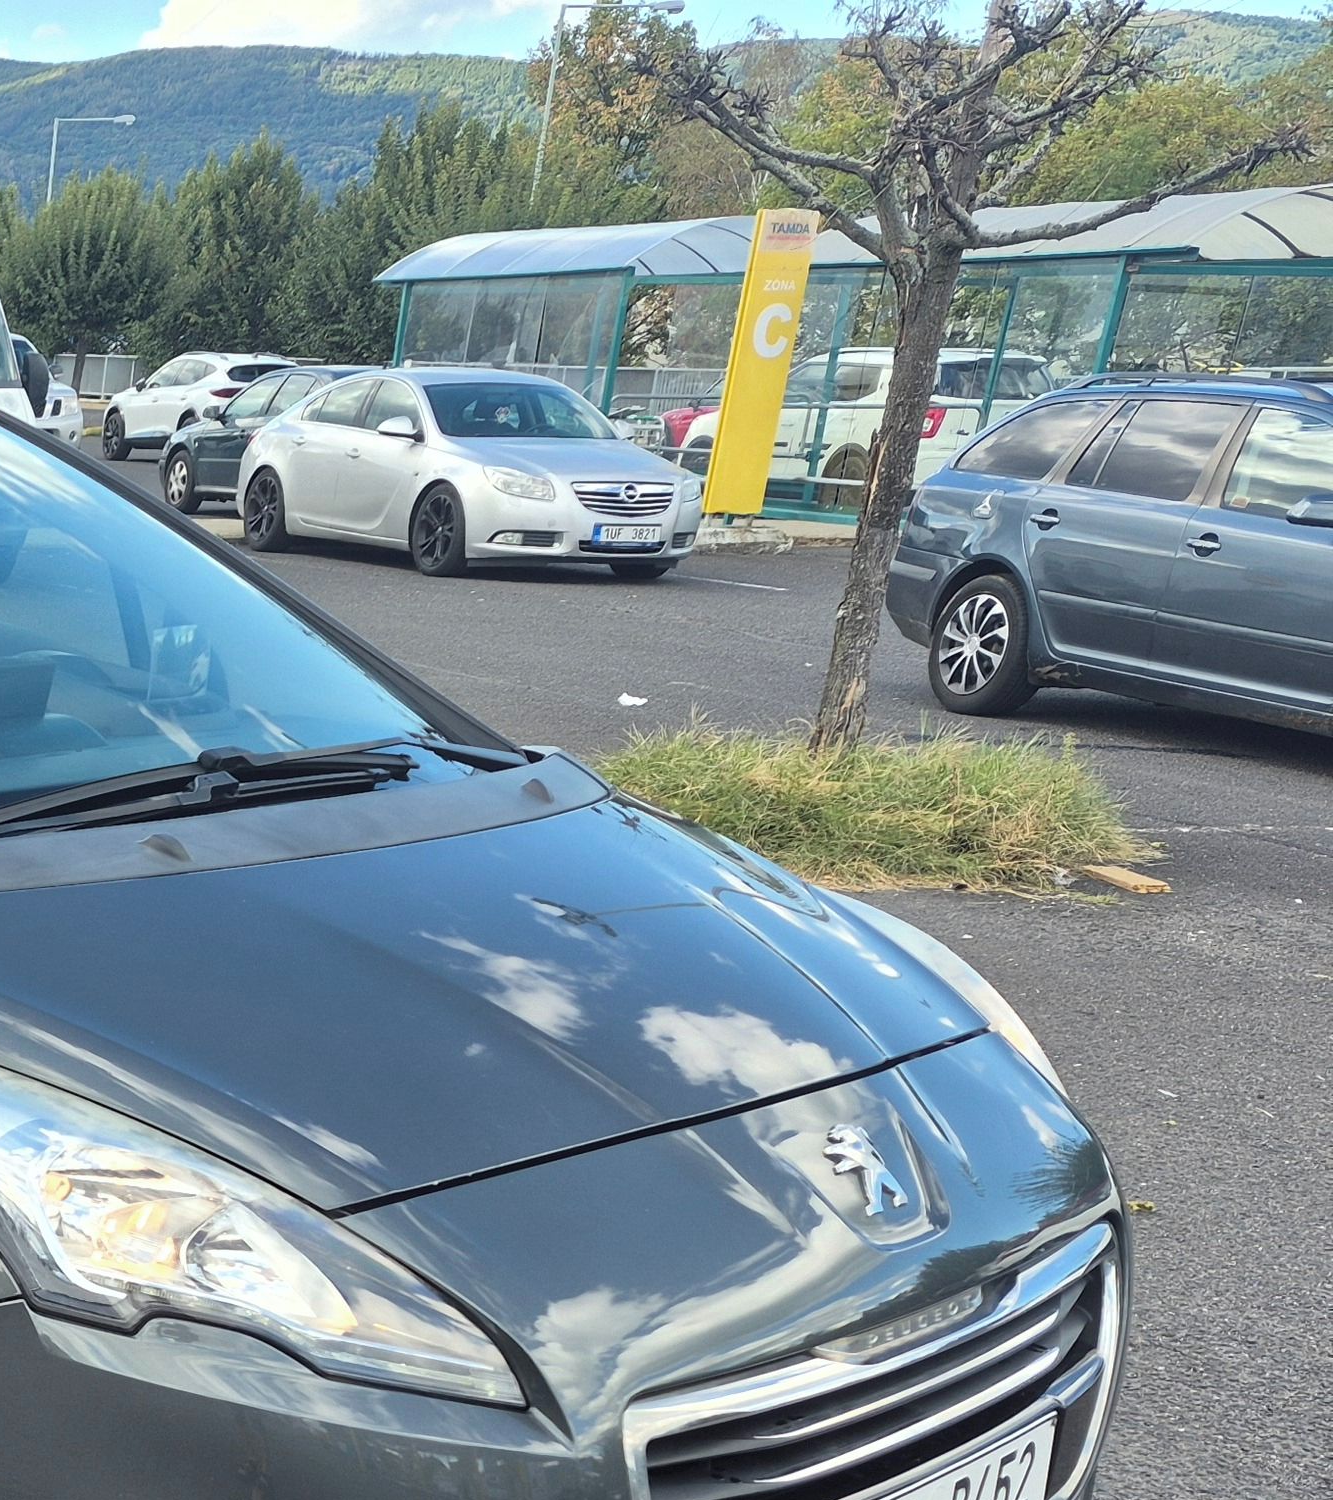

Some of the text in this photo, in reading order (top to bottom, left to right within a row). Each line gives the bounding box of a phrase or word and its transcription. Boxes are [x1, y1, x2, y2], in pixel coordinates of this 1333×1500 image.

[770, 222, 811, 234] TAMDA
[753, 303, 793, 359] C
[604, 527, 656, 540] 1UF 3821
